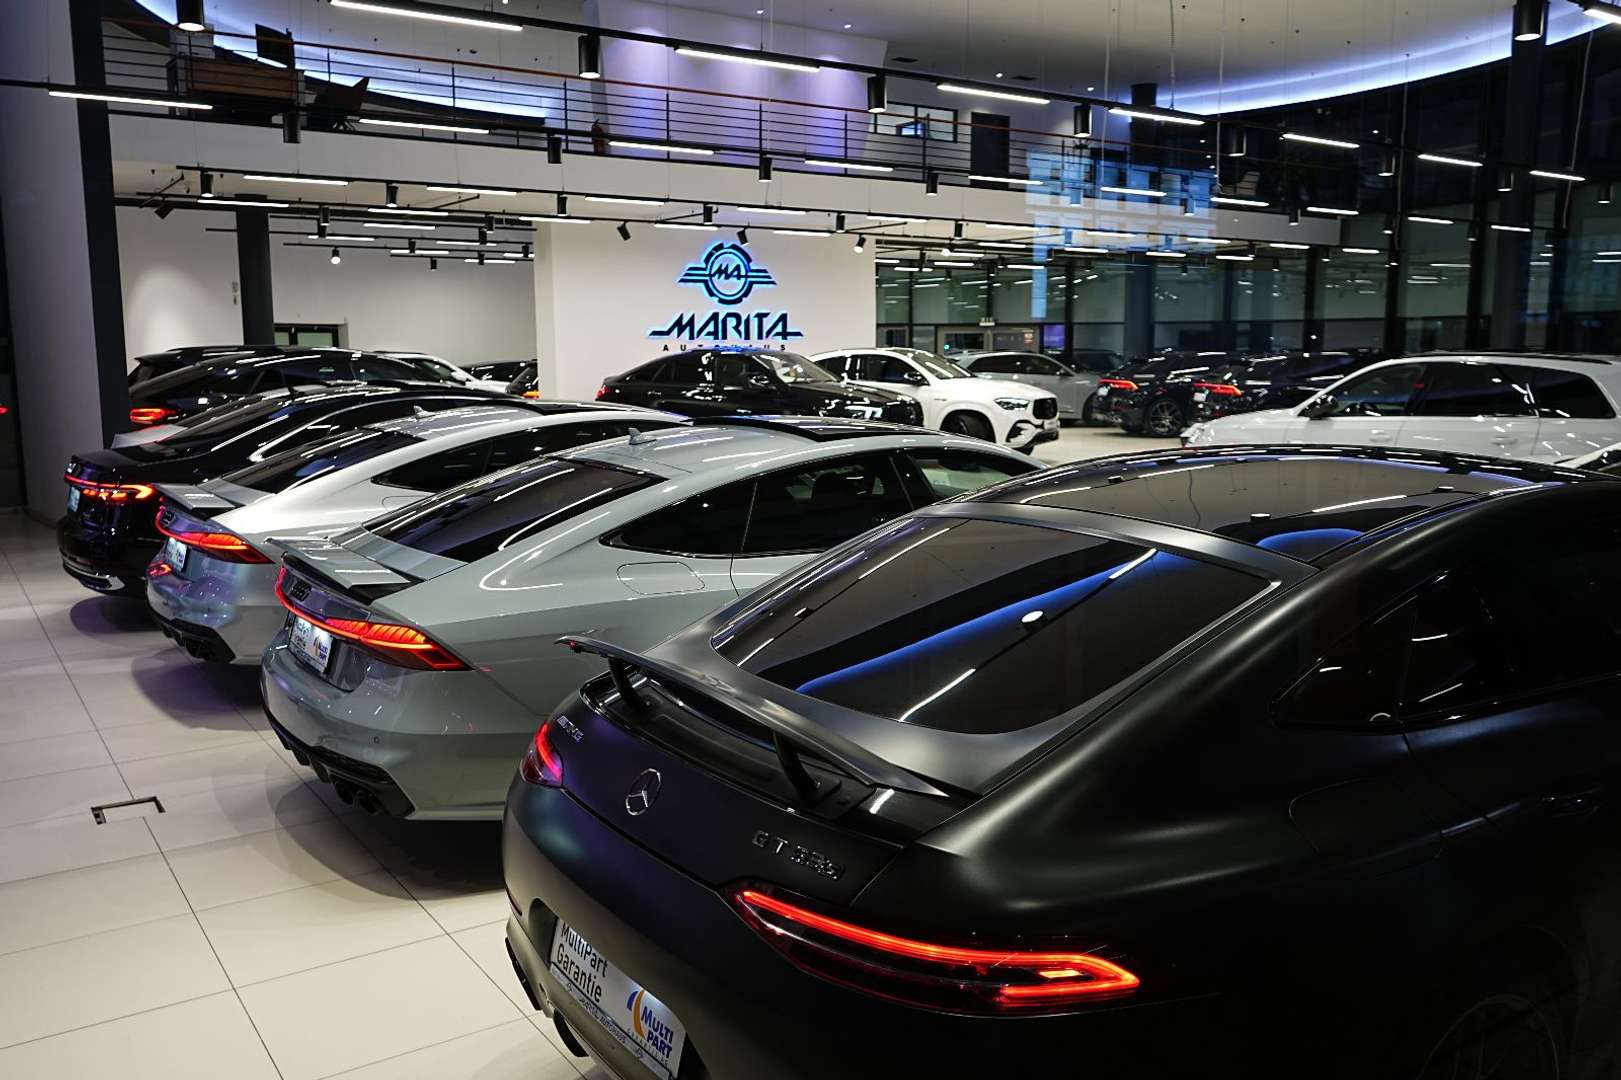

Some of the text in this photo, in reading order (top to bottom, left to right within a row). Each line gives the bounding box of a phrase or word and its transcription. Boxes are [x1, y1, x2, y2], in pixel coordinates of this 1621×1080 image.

[713, 264, 742, 280] MA
[648, 311, 804, 341] MARITA
[560, 922, 609, 978] MultiPart
[556, 943, 602, 1004] Garantie
[641, 1005, 674, 1044] MULTI
[647, 1029, 673, 1059] PART
